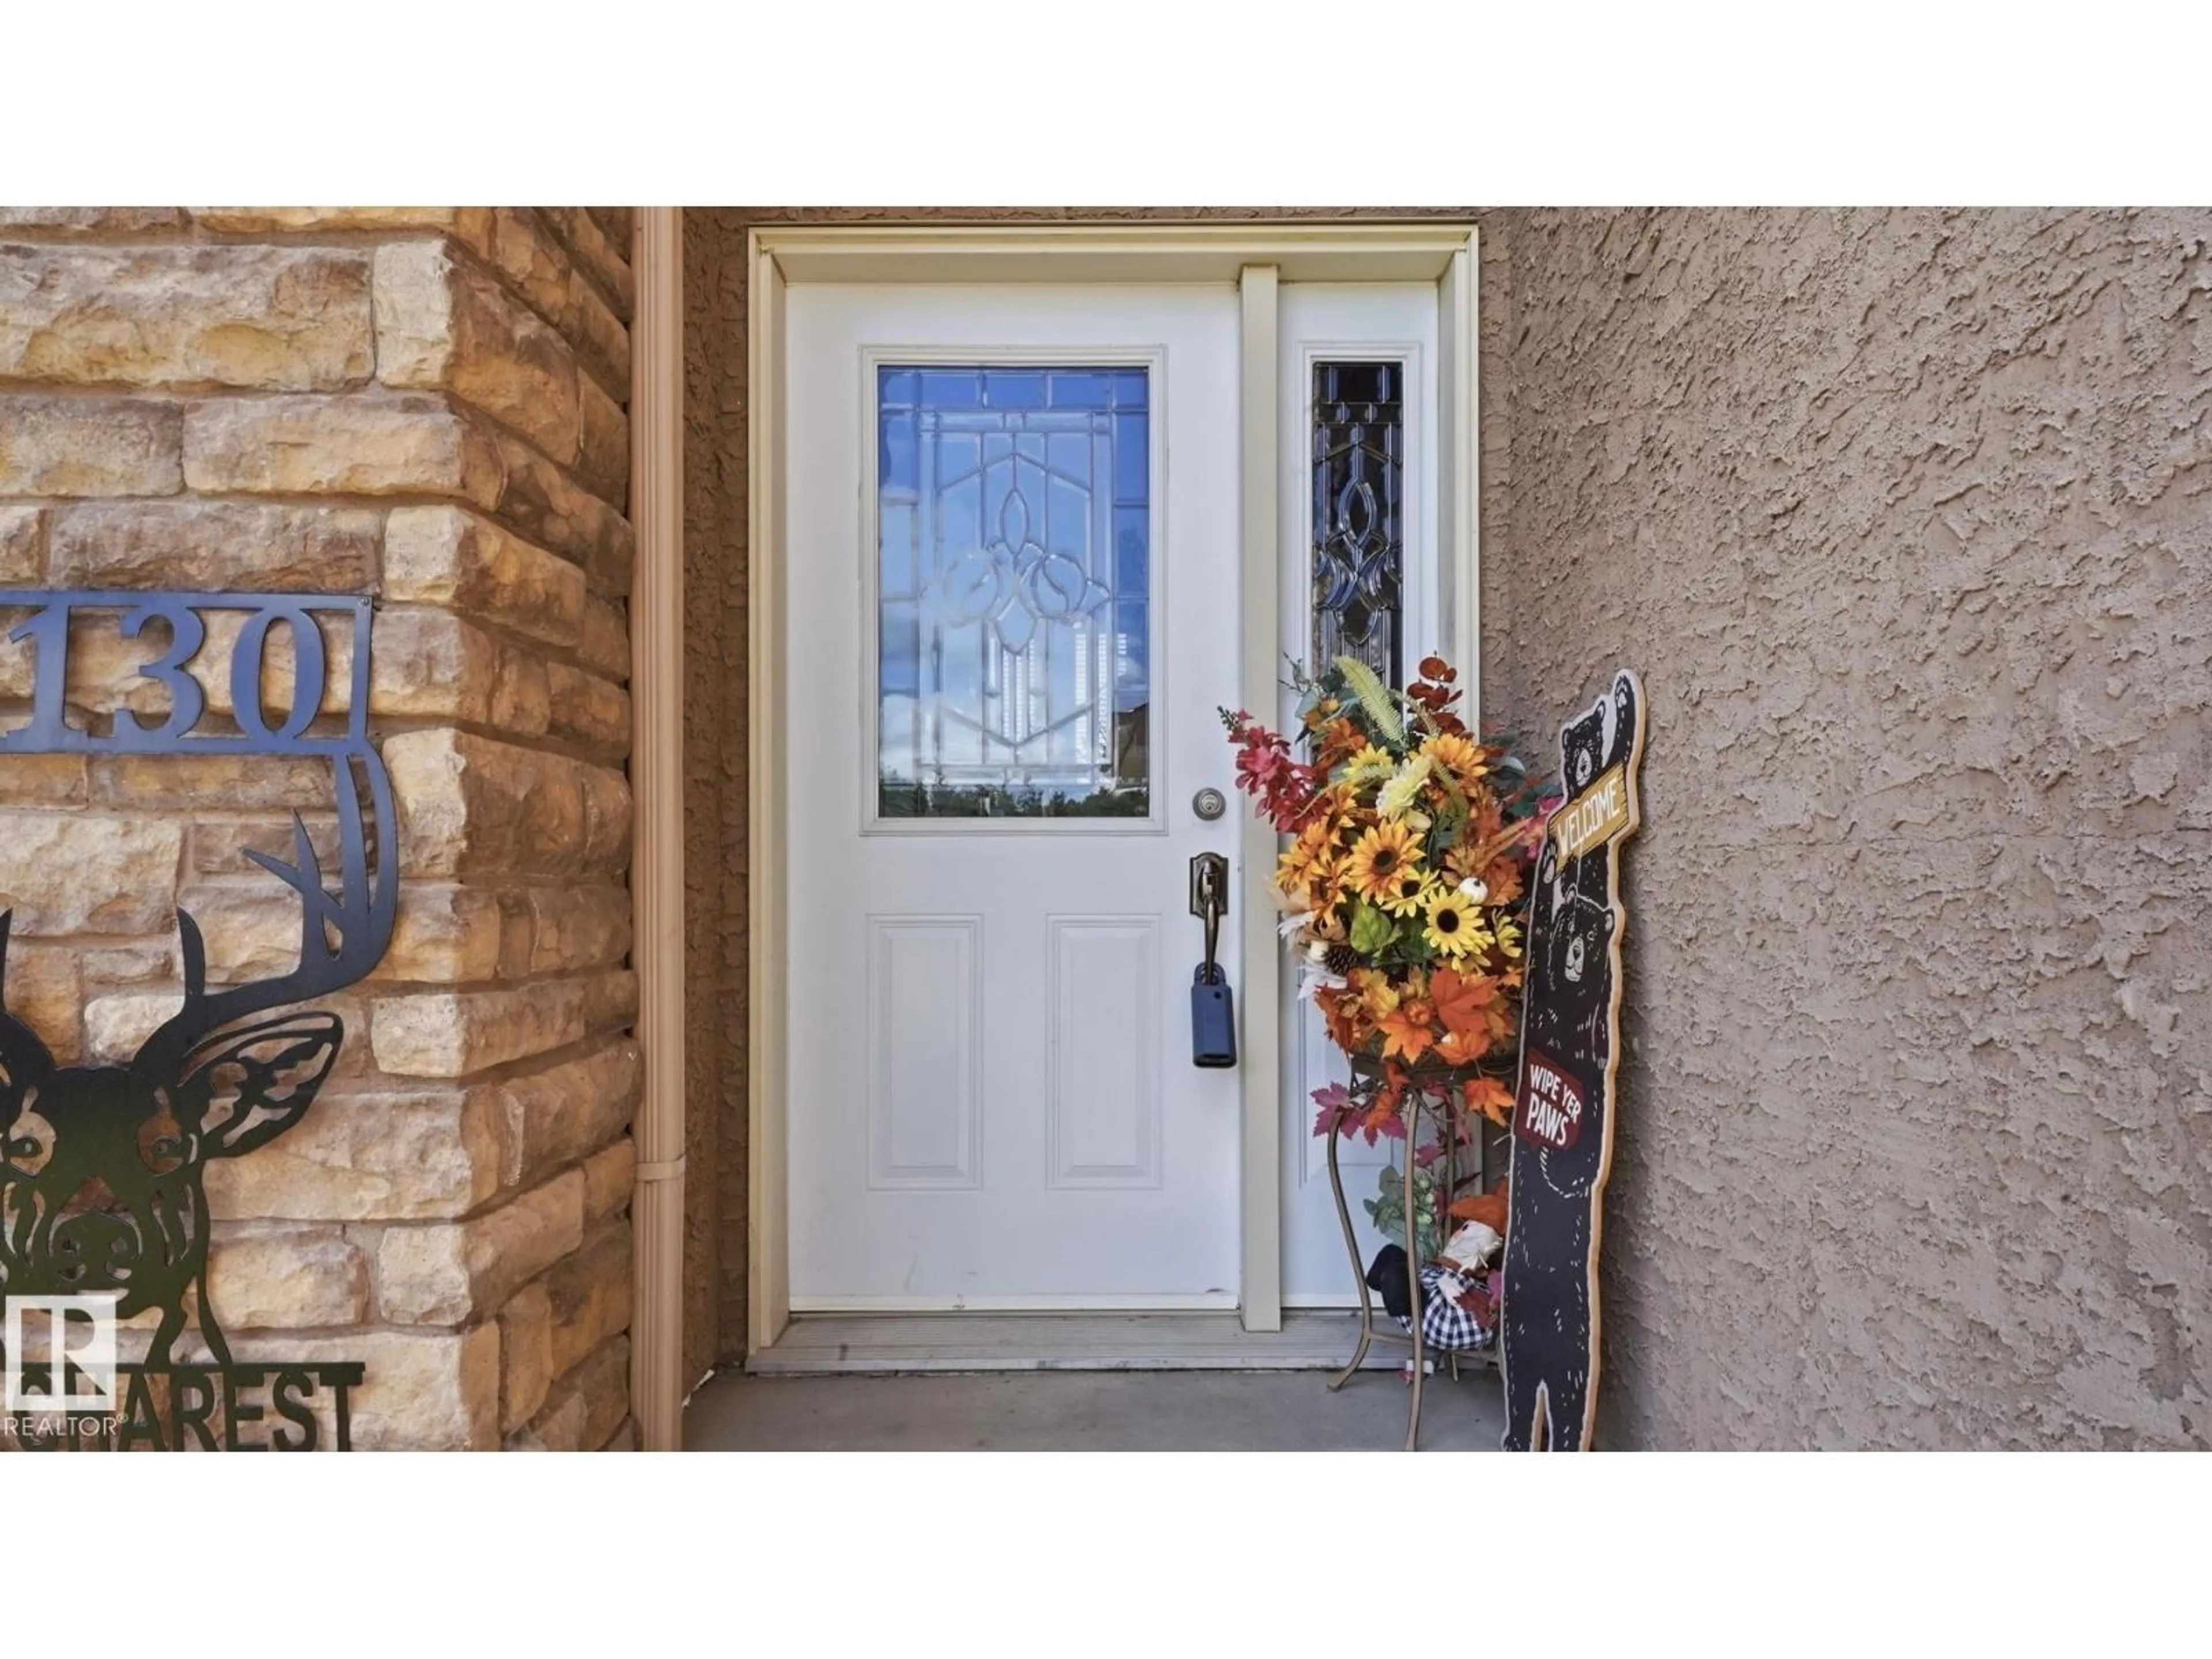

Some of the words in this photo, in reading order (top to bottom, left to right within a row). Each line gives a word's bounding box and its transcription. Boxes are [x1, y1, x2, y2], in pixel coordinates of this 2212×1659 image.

[6, 590, 325, 752] 130
[1558, 777, 1620, 857] WELCOME
[1527, 1092, 1569, 1146] PAWS
[1530, 1064, 1562, 1101] WIPE
[1562, 1084, 1581, 1124] YER
